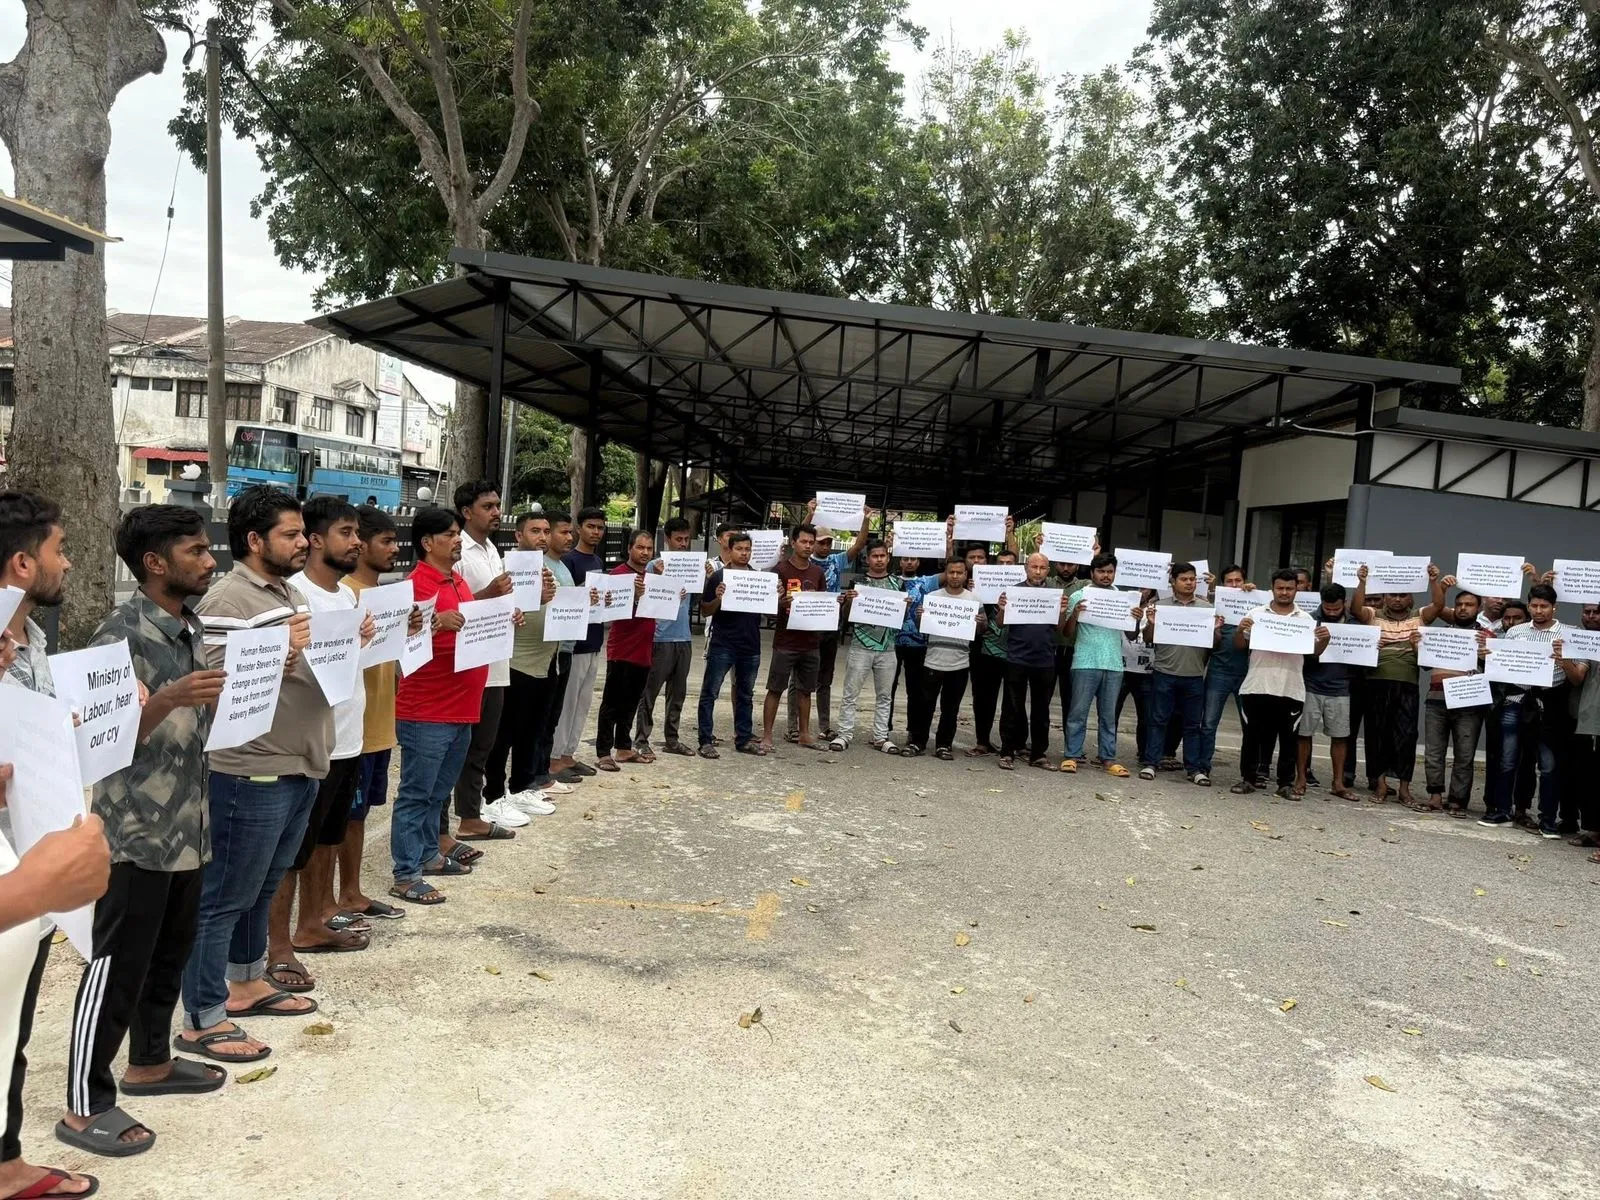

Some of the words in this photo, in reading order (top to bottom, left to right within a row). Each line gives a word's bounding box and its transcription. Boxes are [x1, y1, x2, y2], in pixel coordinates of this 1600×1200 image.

[393, 608, 410, 617] Labour
[313, 641, 323, 649] are
[324, 639, 346, 648] workers
[240, 648, 258, 656] Human
[259, 645, 281, 654] Resources
[327, 651, 348, 665] justice!
[236, 664, 256, 672] Minister
[256, 660, 271, 669] Steven
[88, 667, 122, 690] Ministry
[124, 660, 130, 679] of
[232, 680, 250, 690] change
[232, 695, 242, 705] free
[249, 692, 260, 700] from
[83, 700, 112, 723] Labour,
[115, 693, 132, 710] hear
[229, 710, 248, 720] slavery
[90, 731, 106, 748] our
[107, 725, 120, 743] cry
